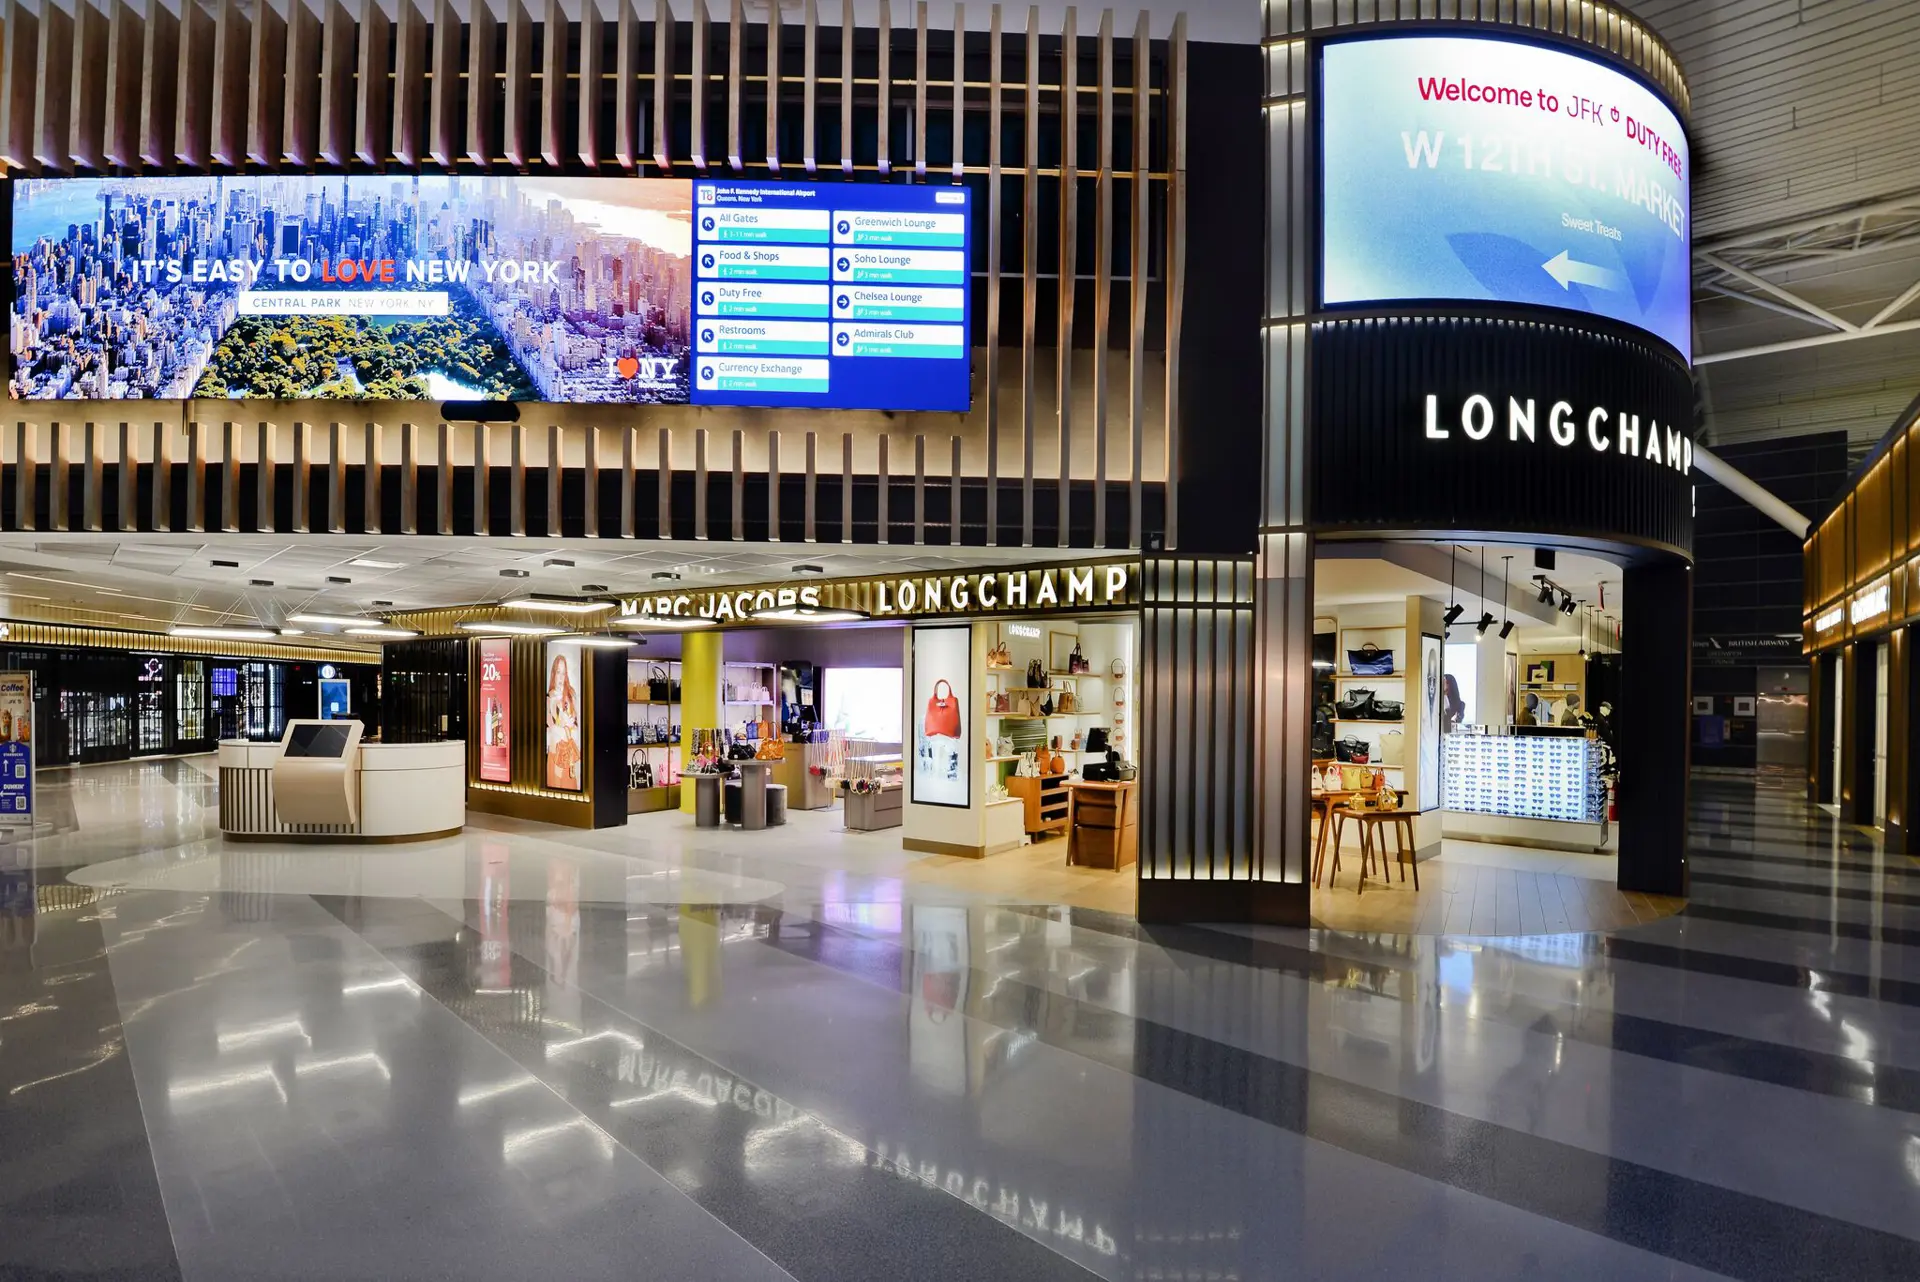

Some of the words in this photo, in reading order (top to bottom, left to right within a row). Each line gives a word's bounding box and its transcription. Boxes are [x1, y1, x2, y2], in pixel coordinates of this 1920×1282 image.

[1418, 77, 1532, 107] Welcome
[1537, 89, 1559, 112] to
[1566, 95, 1603, 126] JFK
[1626, 116, 1660, 155] DUTY
[1662, 141, 1682, 181] FREE
[736, 188, 759, 197] Kennedy
[1401, 131, 1444, 169] W
[1457, 133, 1550, 178] 12TH
[1615, 165, 1685, 243] MARKET
[719, 213, 731, 222] All
[733, 214, 758, 223] Gates
[854, 217, 903, 227] Greenwich
[904, 219, 937, 230] Lounge
[1561, 212, 1594, 233] Sweet
[1595, 218, 1623, 242] Treats
[719, 250, 742, 260] Food
[743, 251, 751, 260] &
[753, 251, 780, 262] Shops
[854, 254, 877, 264] Soho
[878, 255, 912, 266] Lounge
[132, 258, 182, 284] IT'S
[192, 258, 264, 284] EASY
[274, 258, 312, 284] TO
[322, 258, 395, 283] LOVE
[406, 259, 471, 284] NEW
[482, 260, 563, 284] YORK
[719, 287, 740, 298] Duty
[742, 288, 762, 298] Free
[854, 291, 888, 301] Chelsea
[890, 292, 923, 303] Lounge
[252, 298, 307, 308] CENTRAL
[310, 298, 341, 308] PARK
[348, 298, 374, 308] NEW
[418, 299, 434, 308] NY
[719, 325, 766, 336] Restrooms
[854, 329, 892, 339] Admirals
[894, 329, 915, 339] Club
[605, 357, 617, 378] I
[638, 357, 679, 380] NY
[719, 362, 759, 374] Currency
[761, 363, 803, 375] Exchange
[1425, 394, 1692, 476] LONGCHAMP
[879, 566, 1128, 612] LONGCHAMP
[621, 595, 690, 617] MARC
[699, 586, 820, 620] JACOBS
[1728, 639, 1758, 647] BRITISH
[1759, 639, 1790, 647] AIRWAYS
[482, 663, 501, 681] 20%
[1, 683, 25, 692] Coffee
